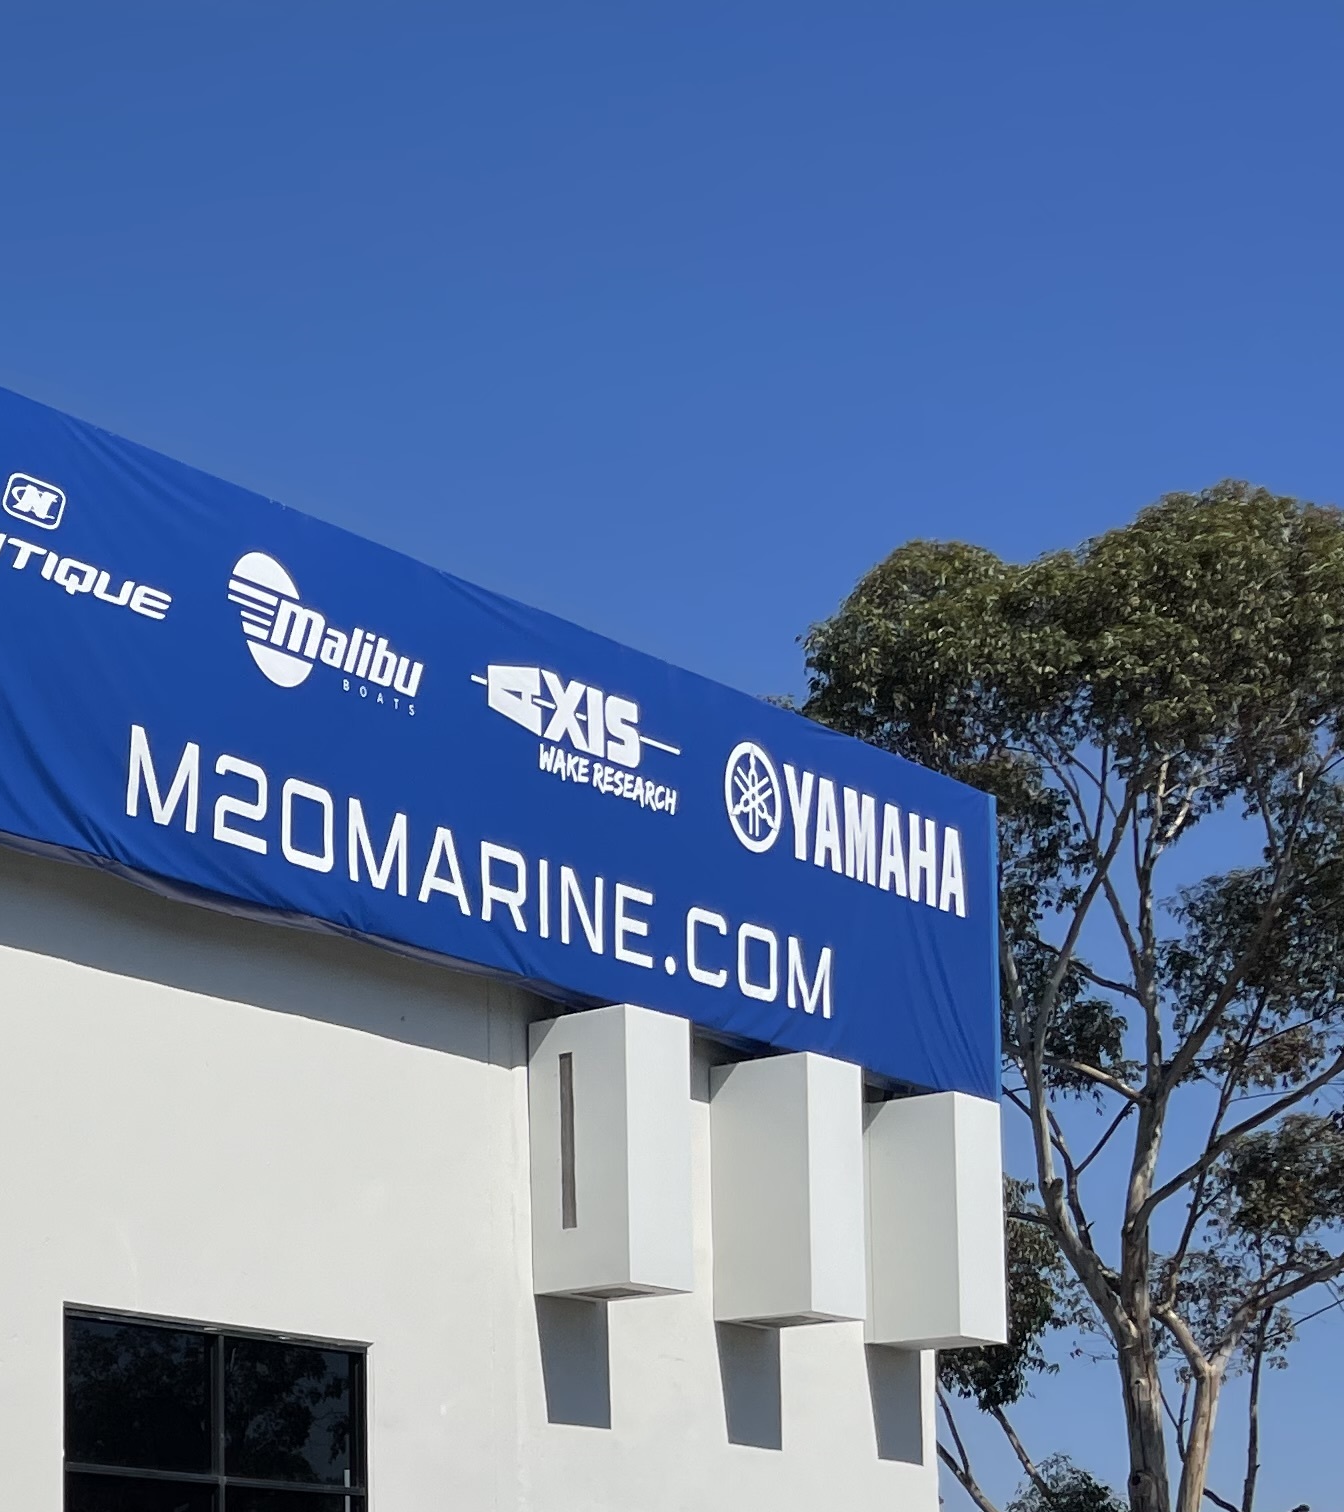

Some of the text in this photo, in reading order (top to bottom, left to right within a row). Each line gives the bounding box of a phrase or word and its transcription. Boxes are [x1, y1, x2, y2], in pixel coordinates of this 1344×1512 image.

[268, 598, 424, 698] Malibu
[342, 679, 416, 715] BOATS
[487, 664, 642, 769] AXIS
[538, 743, 677, 816] WAKE RESEARCH
[782, 763, 967, 918] YAMAHA
